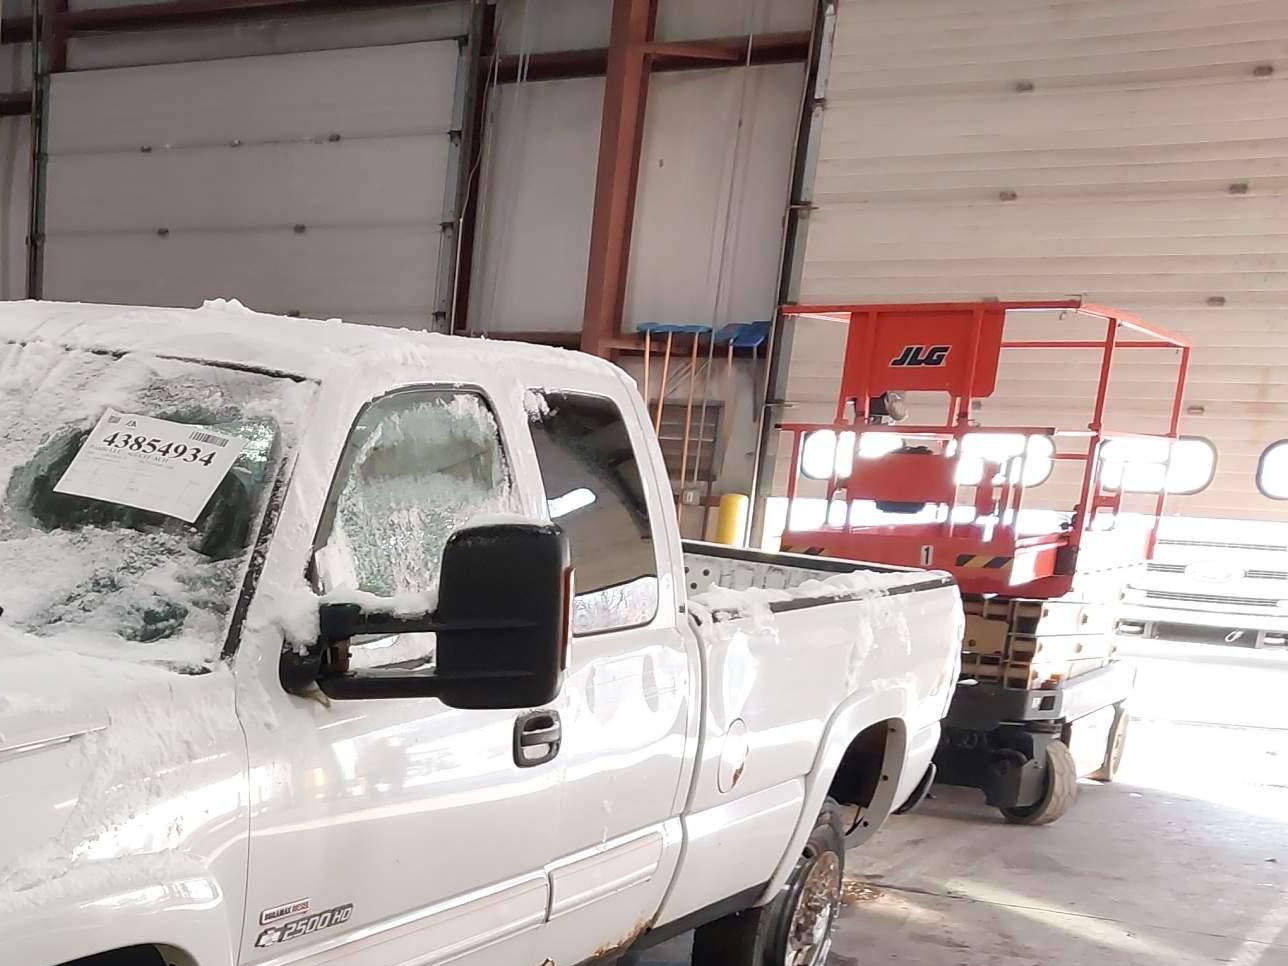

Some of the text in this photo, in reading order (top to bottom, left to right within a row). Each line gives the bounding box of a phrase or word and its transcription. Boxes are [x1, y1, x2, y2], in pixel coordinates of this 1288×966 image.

[889, 345, 952, 367] JLG
[103, 431, 217, 467] 43854934
[282, 907, 352, 941] 2500 HD
